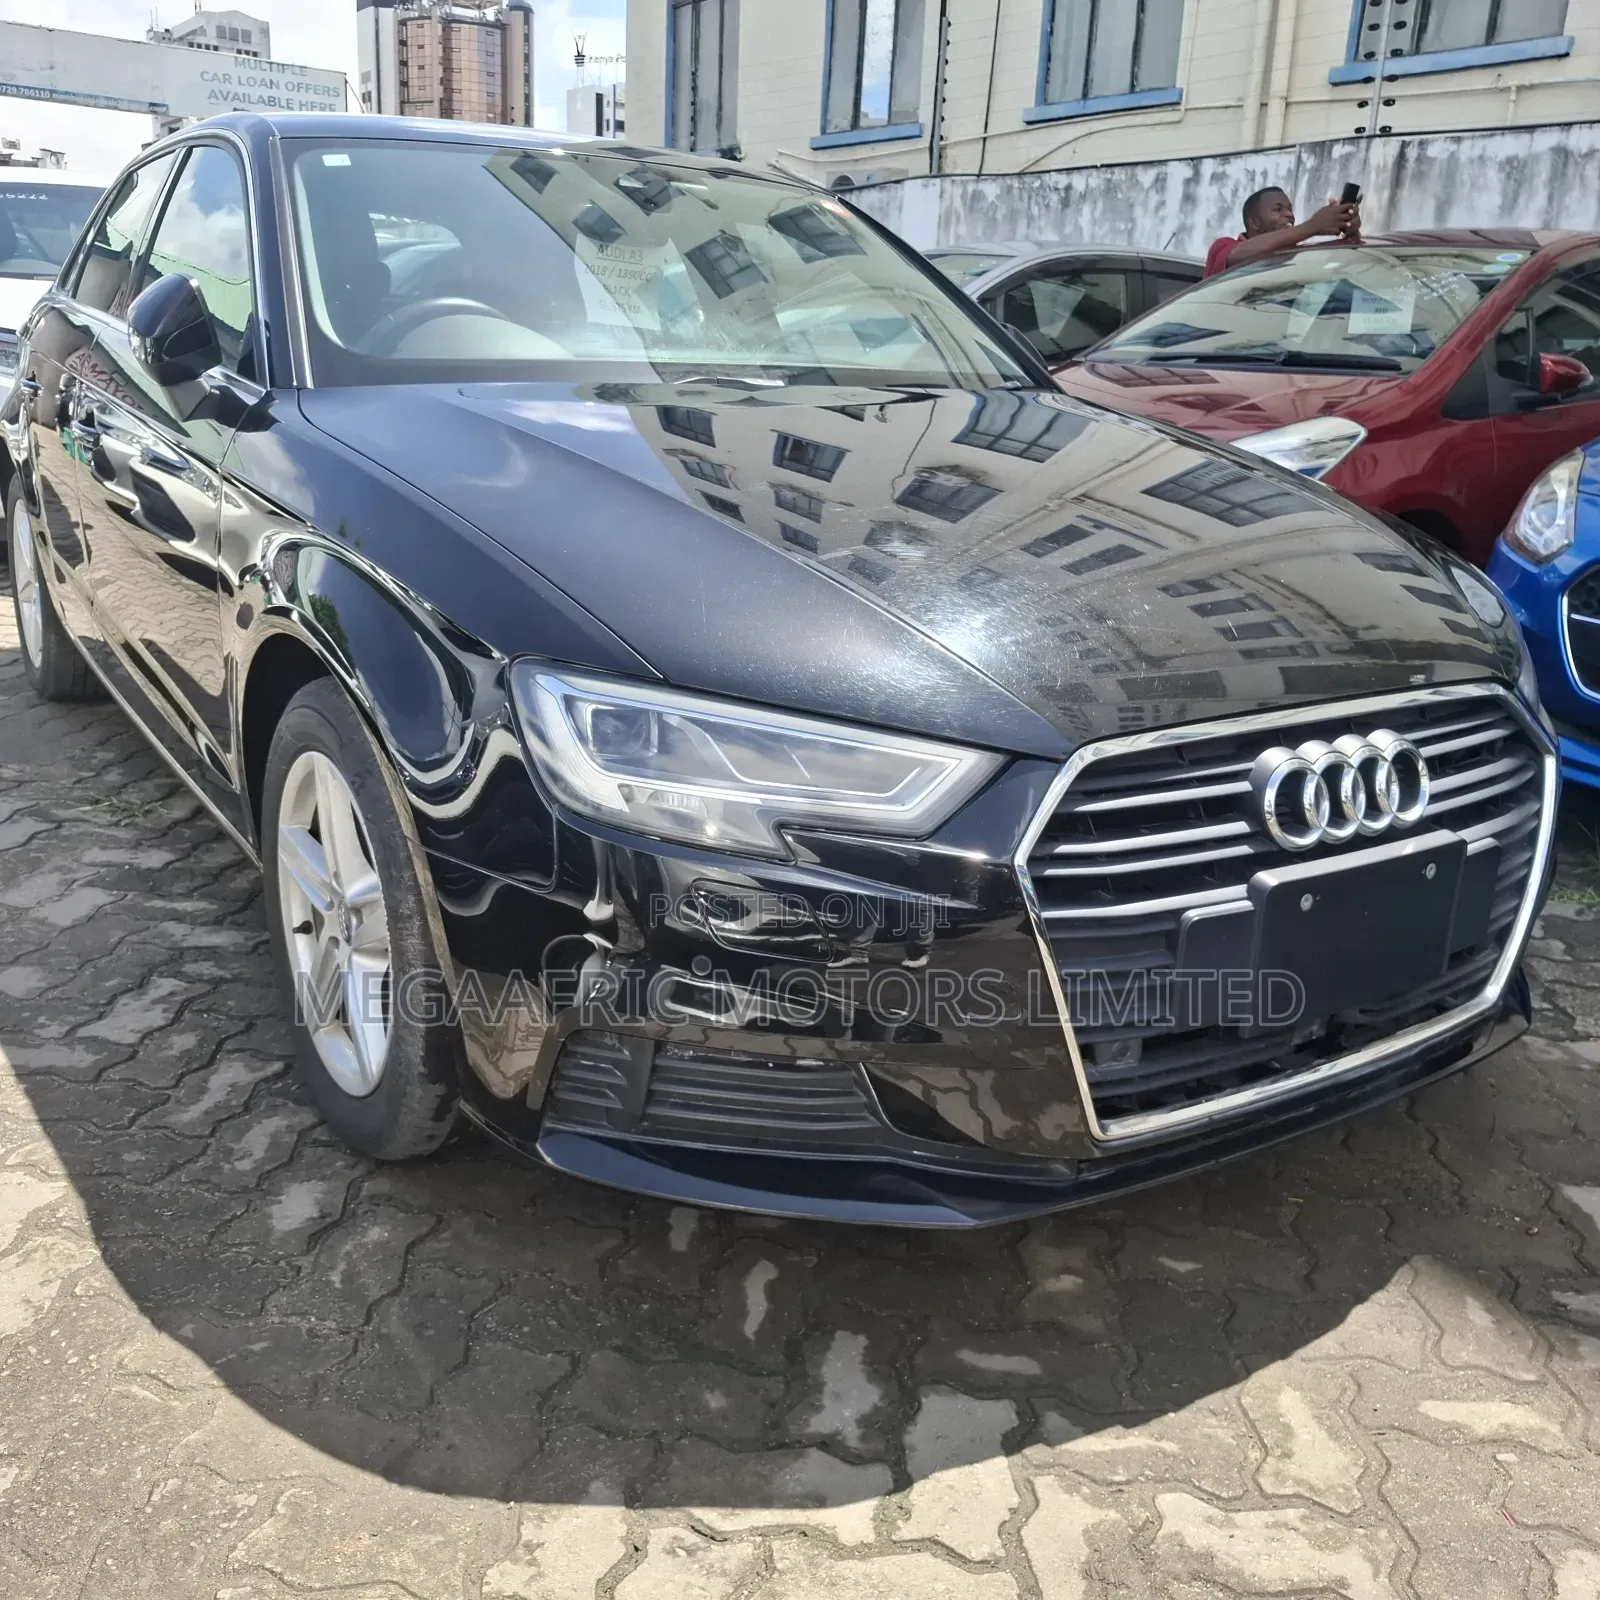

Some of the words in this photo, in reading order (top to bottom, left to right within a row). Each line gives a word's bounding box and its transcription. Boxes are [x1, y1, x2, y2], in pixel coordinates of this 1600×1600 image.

[234, 56, 308, 77] MULTIPLE
[19, 88, 51, 99] 786110
[200, 71, 232, 85] CAR
[237, 75, 280, 90] LOAN
[284, 81, 341, 98] OFFERS
[207, 89, 294, 111] AVAILABLE
[298, 100, 336, 112] HERE
[596, 244, 626, 260] AUDI
[628, 250, 644, 262] A3
[585, 264, 608, 277] 2018
[603, 284, 631, 297] BLACK
